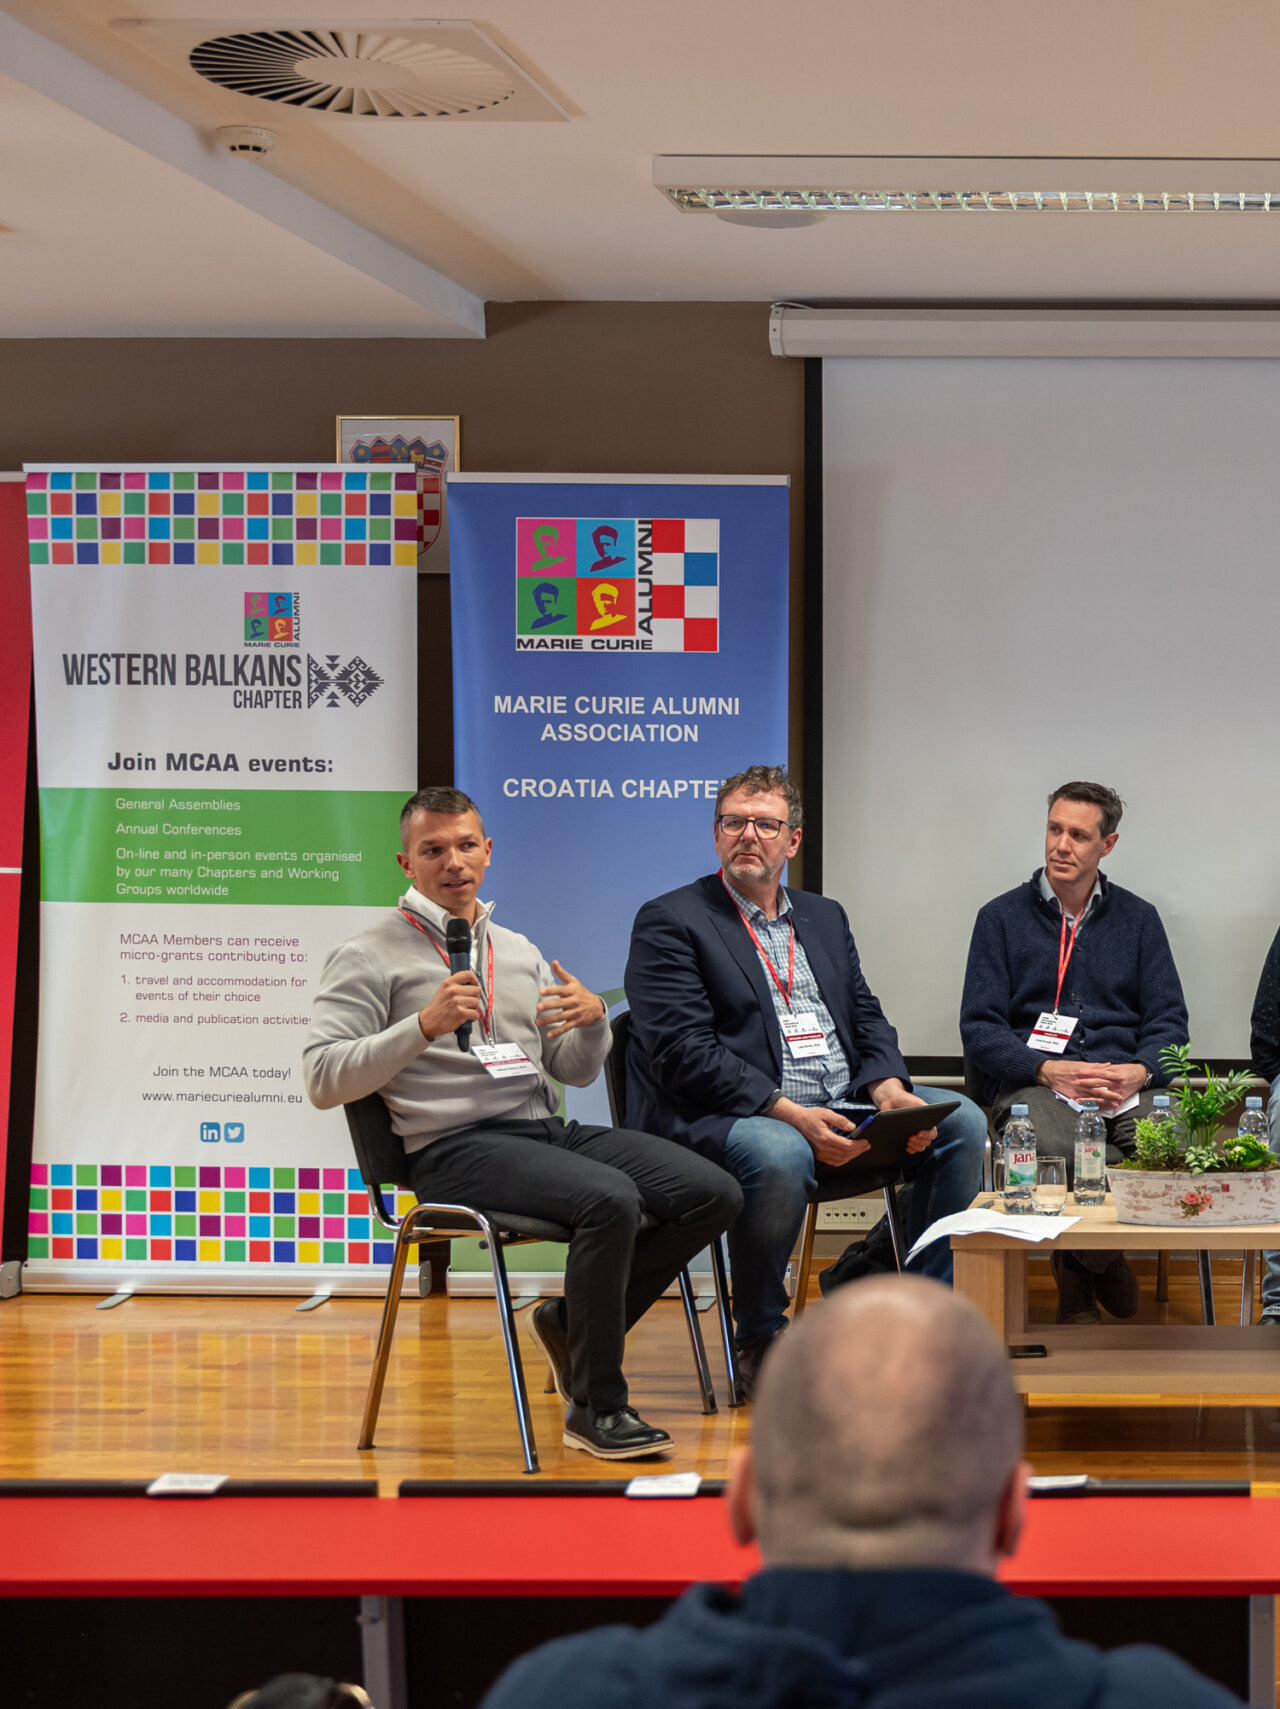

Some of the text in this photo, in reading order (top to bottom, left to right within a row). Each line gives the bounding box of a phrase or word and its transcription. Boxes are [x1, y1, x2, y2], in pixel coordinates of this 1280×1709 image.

[638, 519, 653, 636] ALUMNI
[517, 638, 653, 650] MARIE CURIE
[62, 653, 302, 687] WESTERN BALKANS
[233, 690, 302, 710] CHAPTER
[494, 696, 740, 716] MARIE CURIE ALUMNI
[541, 723, 699, 742] ASSOCIATION
[107, 752, 333, 773] Join MCAA events:
[502, 778, 726, 799] CROATIA CHAPTE
[115, 797, 240, 811] General Assemblies
[115, 823, 241, 836] Annual Conferences
[116, 848, 362, 864] On-line and in-person events organised
[116, 866, 339, 882] by our many Chapters and Working
[116, 883, 229, 898] Groups worldwide
[119, 934, 299, 947] MCAA Members can receive
[119, 950, 308, 965] micro-grants contributing to:
[121, 975, 308, 987] 1. travel and accommodation for
[135, 991, 261, 1002] events of their choice
[120, 1013, 130, 1023] 2.
[136, 1013, 169, 1024] media
[173, 1013, 194, 1024] and
[197, 1013, 259, 1027] publication
[152, 1065, 291, 1081] Join the MCAA today!
[142, 1091, 303, 1104] www.mariecuriealumni.eu
